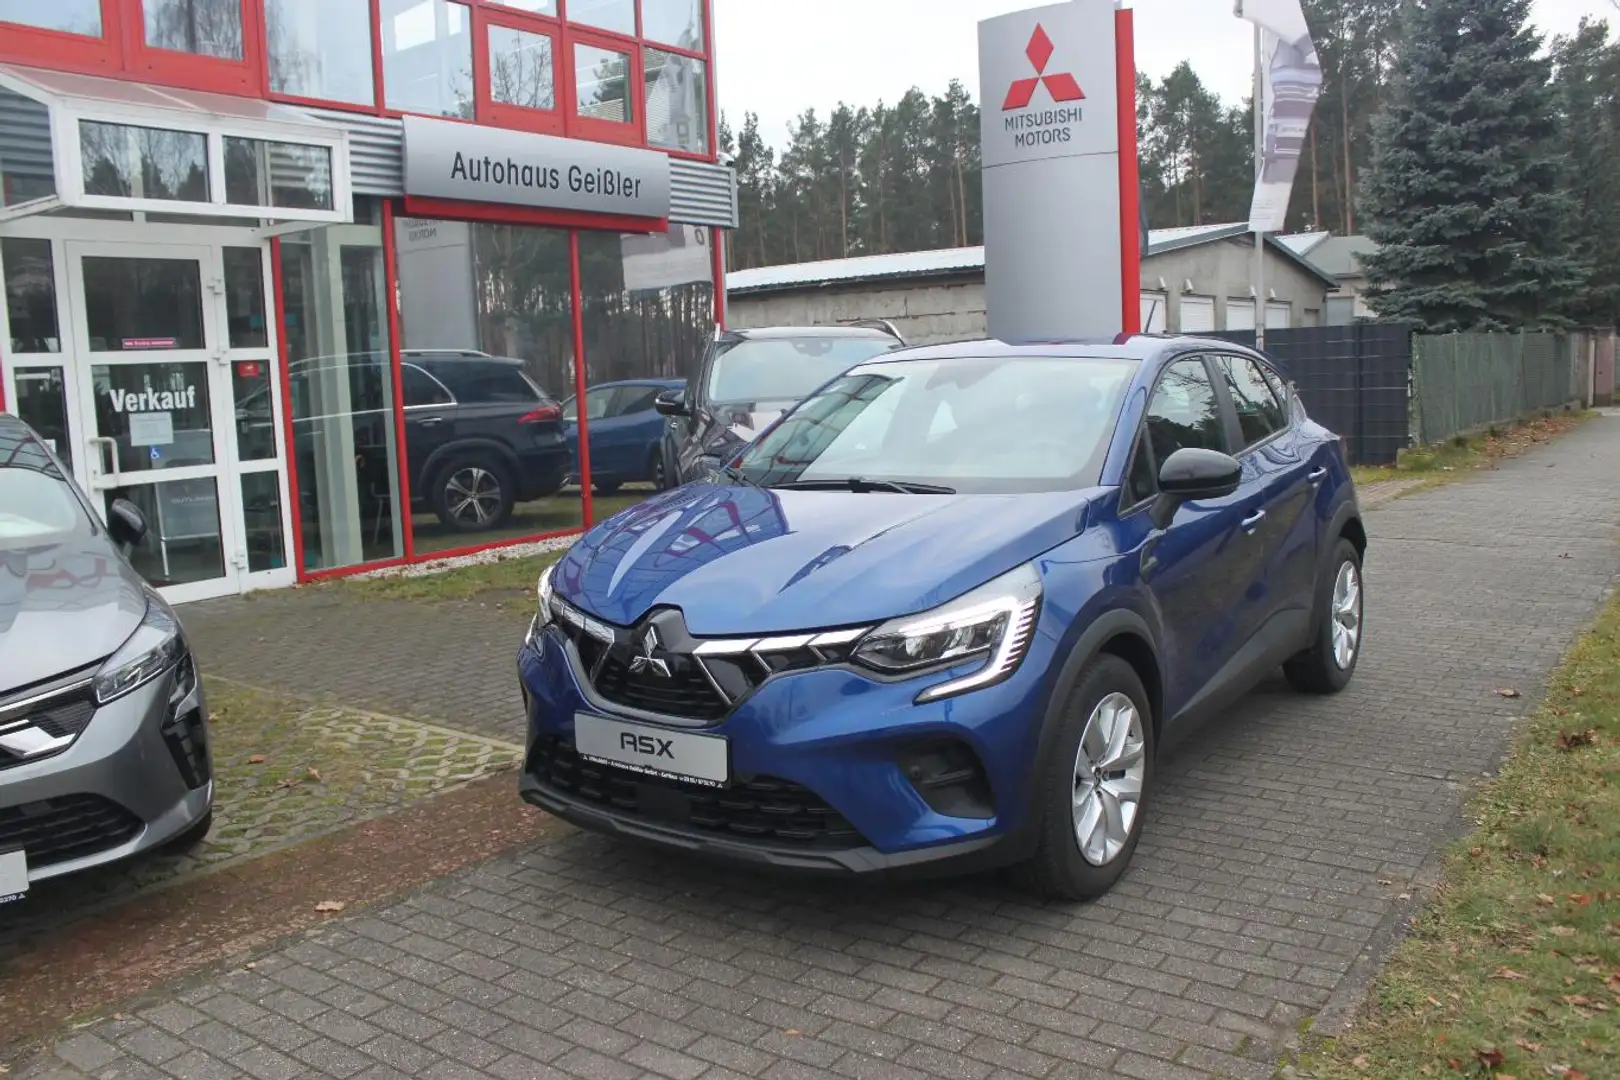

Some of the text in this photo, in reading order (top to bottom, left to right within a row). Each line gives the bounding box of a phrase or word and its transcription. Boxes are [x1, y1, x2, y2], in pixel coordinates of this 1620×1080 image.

[1005, 107, 1082, 131] MITSUBISHI
[1015, 127, 1071, 147] MOTORS
[451, 151, 641, 198] Autohaus Geißler
[109, 385, 195, 412] Verkauf
[620, 732, 675, 760] ASX
